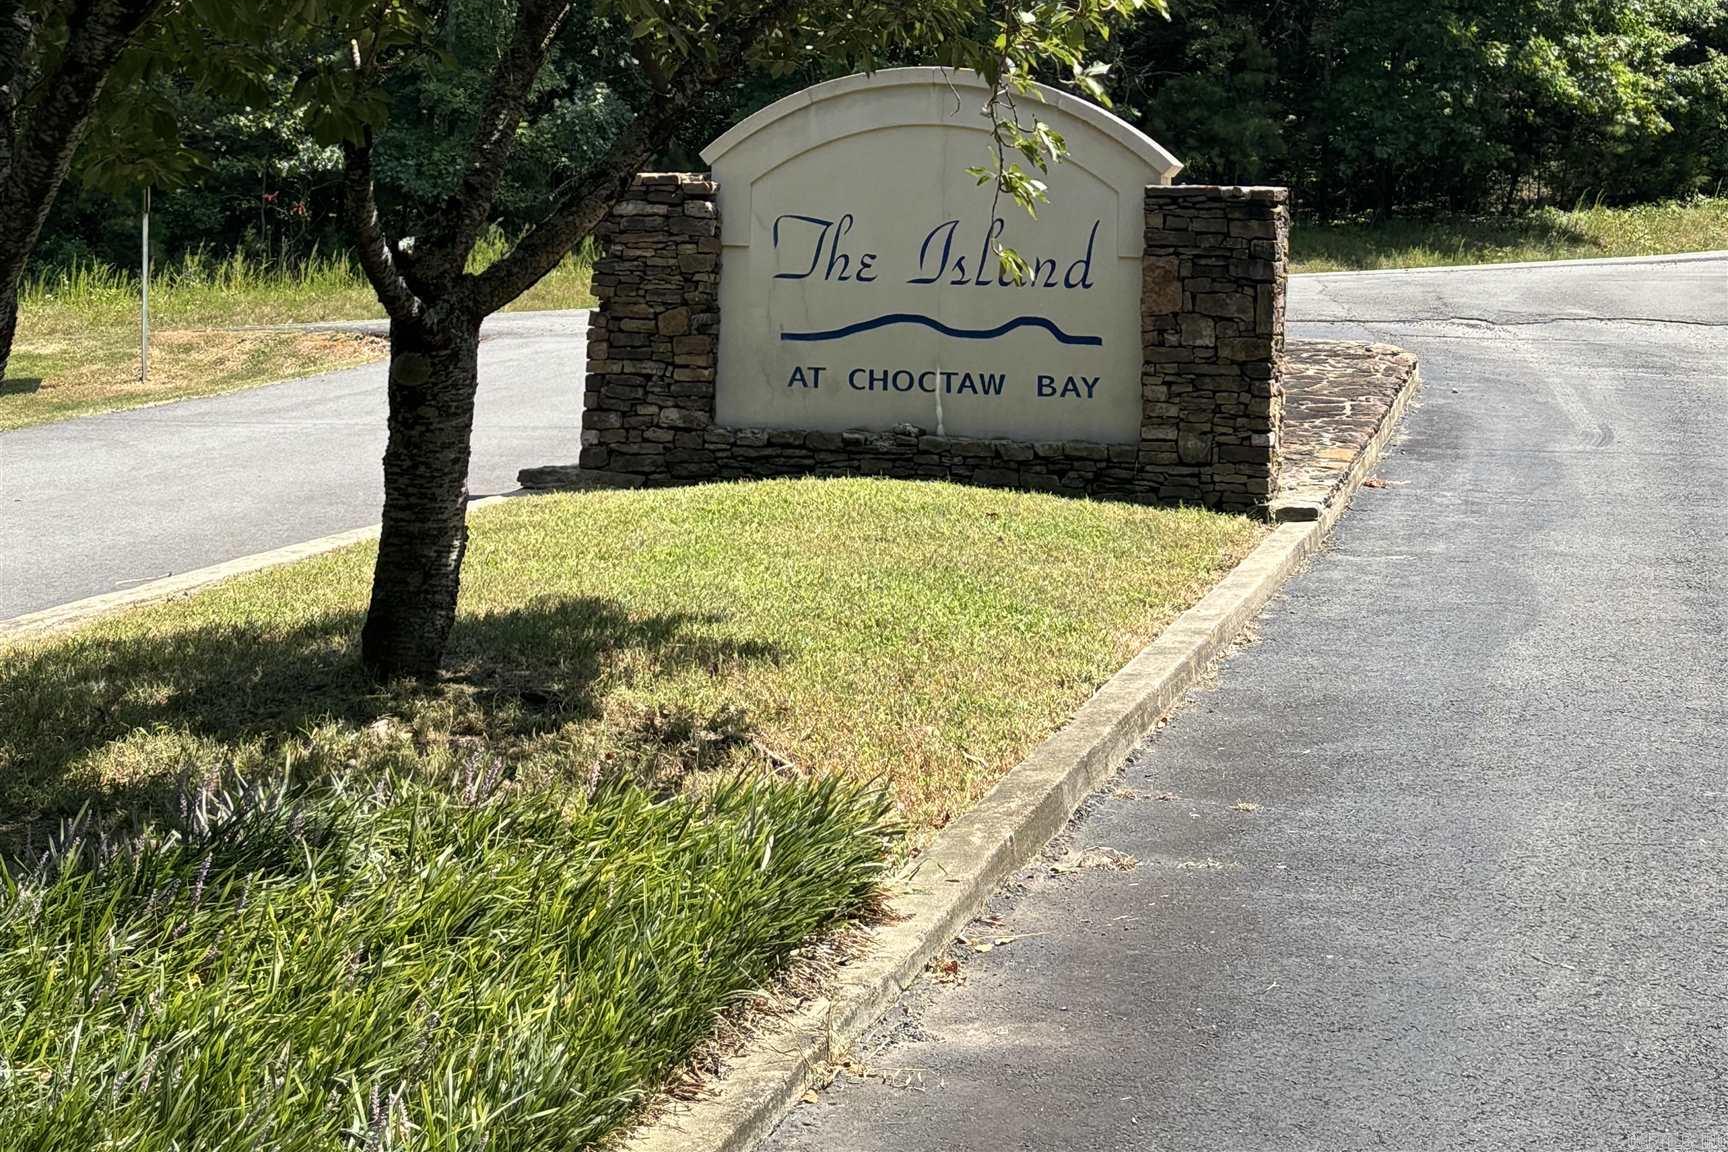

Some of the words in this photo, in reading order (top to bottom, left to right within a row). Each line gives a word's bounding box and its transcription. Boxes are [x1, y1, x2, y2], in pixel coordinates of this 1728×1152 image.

[773, 214, 878, 282] The
[787, 367, 826, 388] AT
[848, 369, 1006, 395] CHOCTAW
[1036, 375, 1101, 398] BAY
